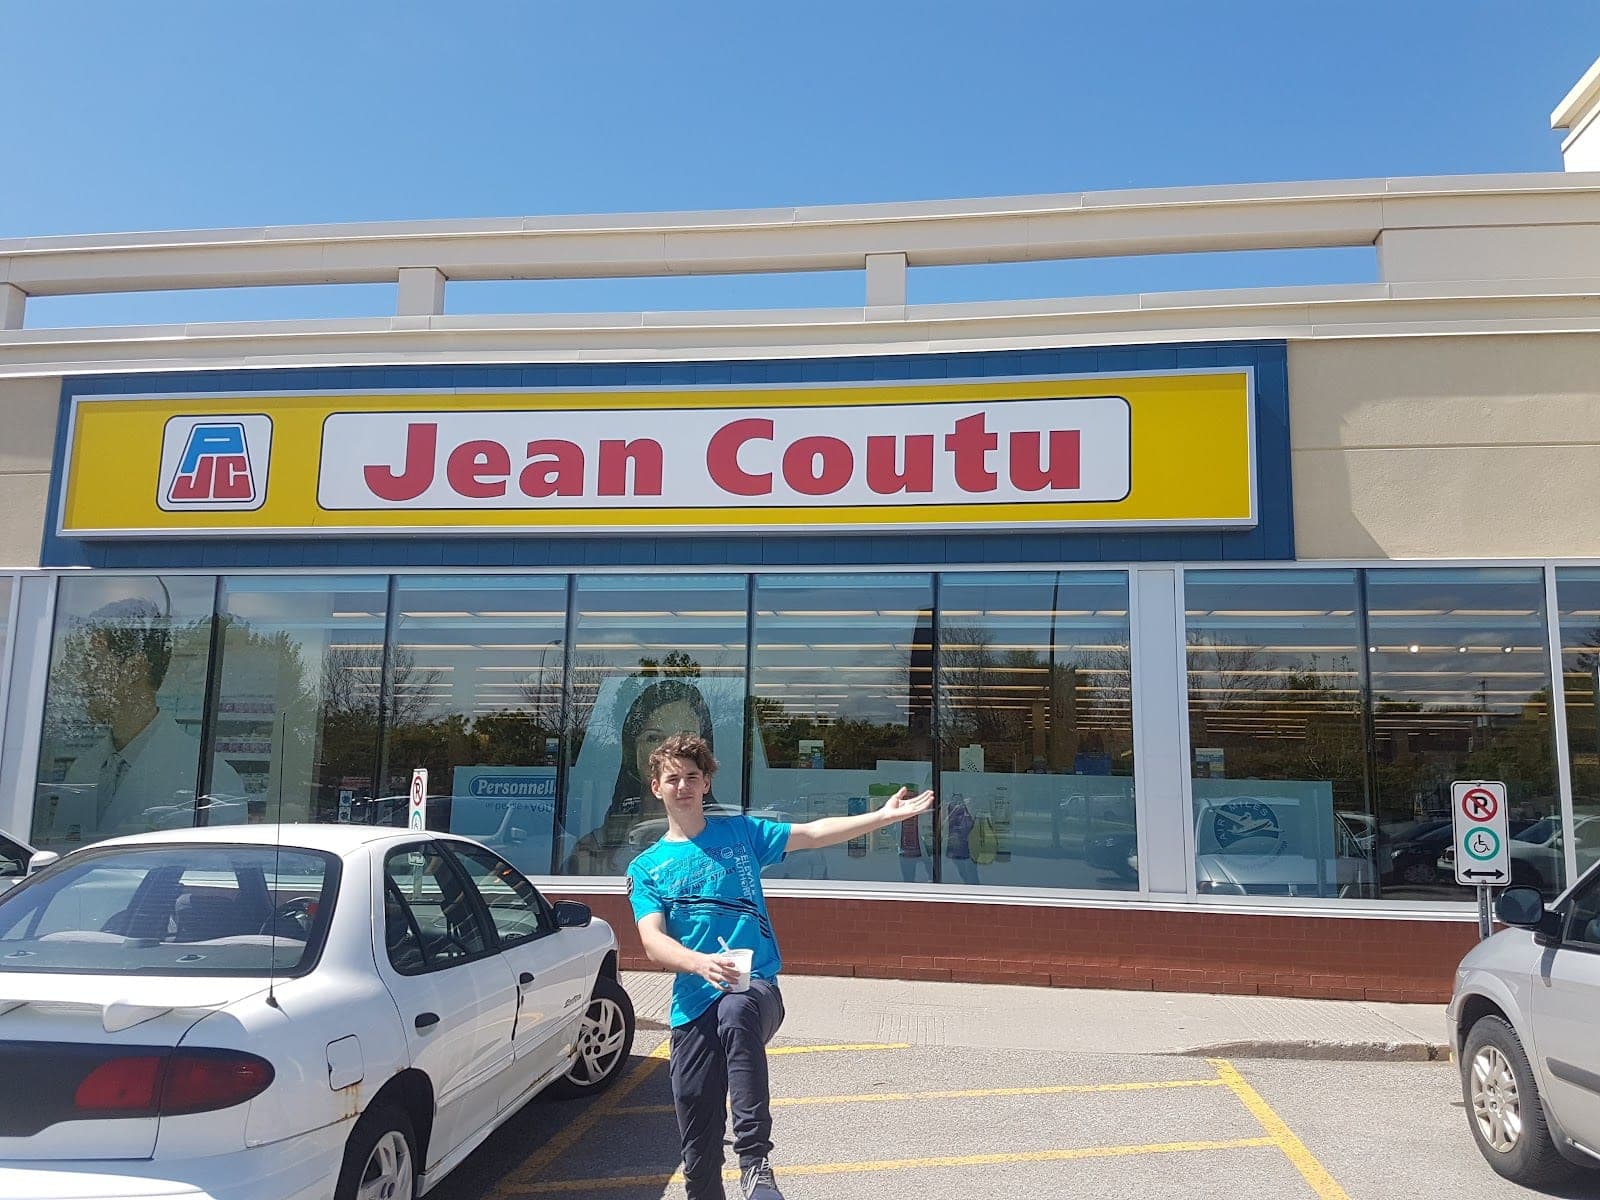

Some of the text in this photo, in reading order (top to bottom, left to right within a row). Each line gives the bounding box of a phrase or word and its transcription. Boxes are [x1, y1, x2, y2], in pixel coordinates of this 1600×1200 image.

[364, 411, 1081, 501] Jean Coutu
[476, 779, 554, 795] Personnell
[1471, 796, 1488, 814] P
